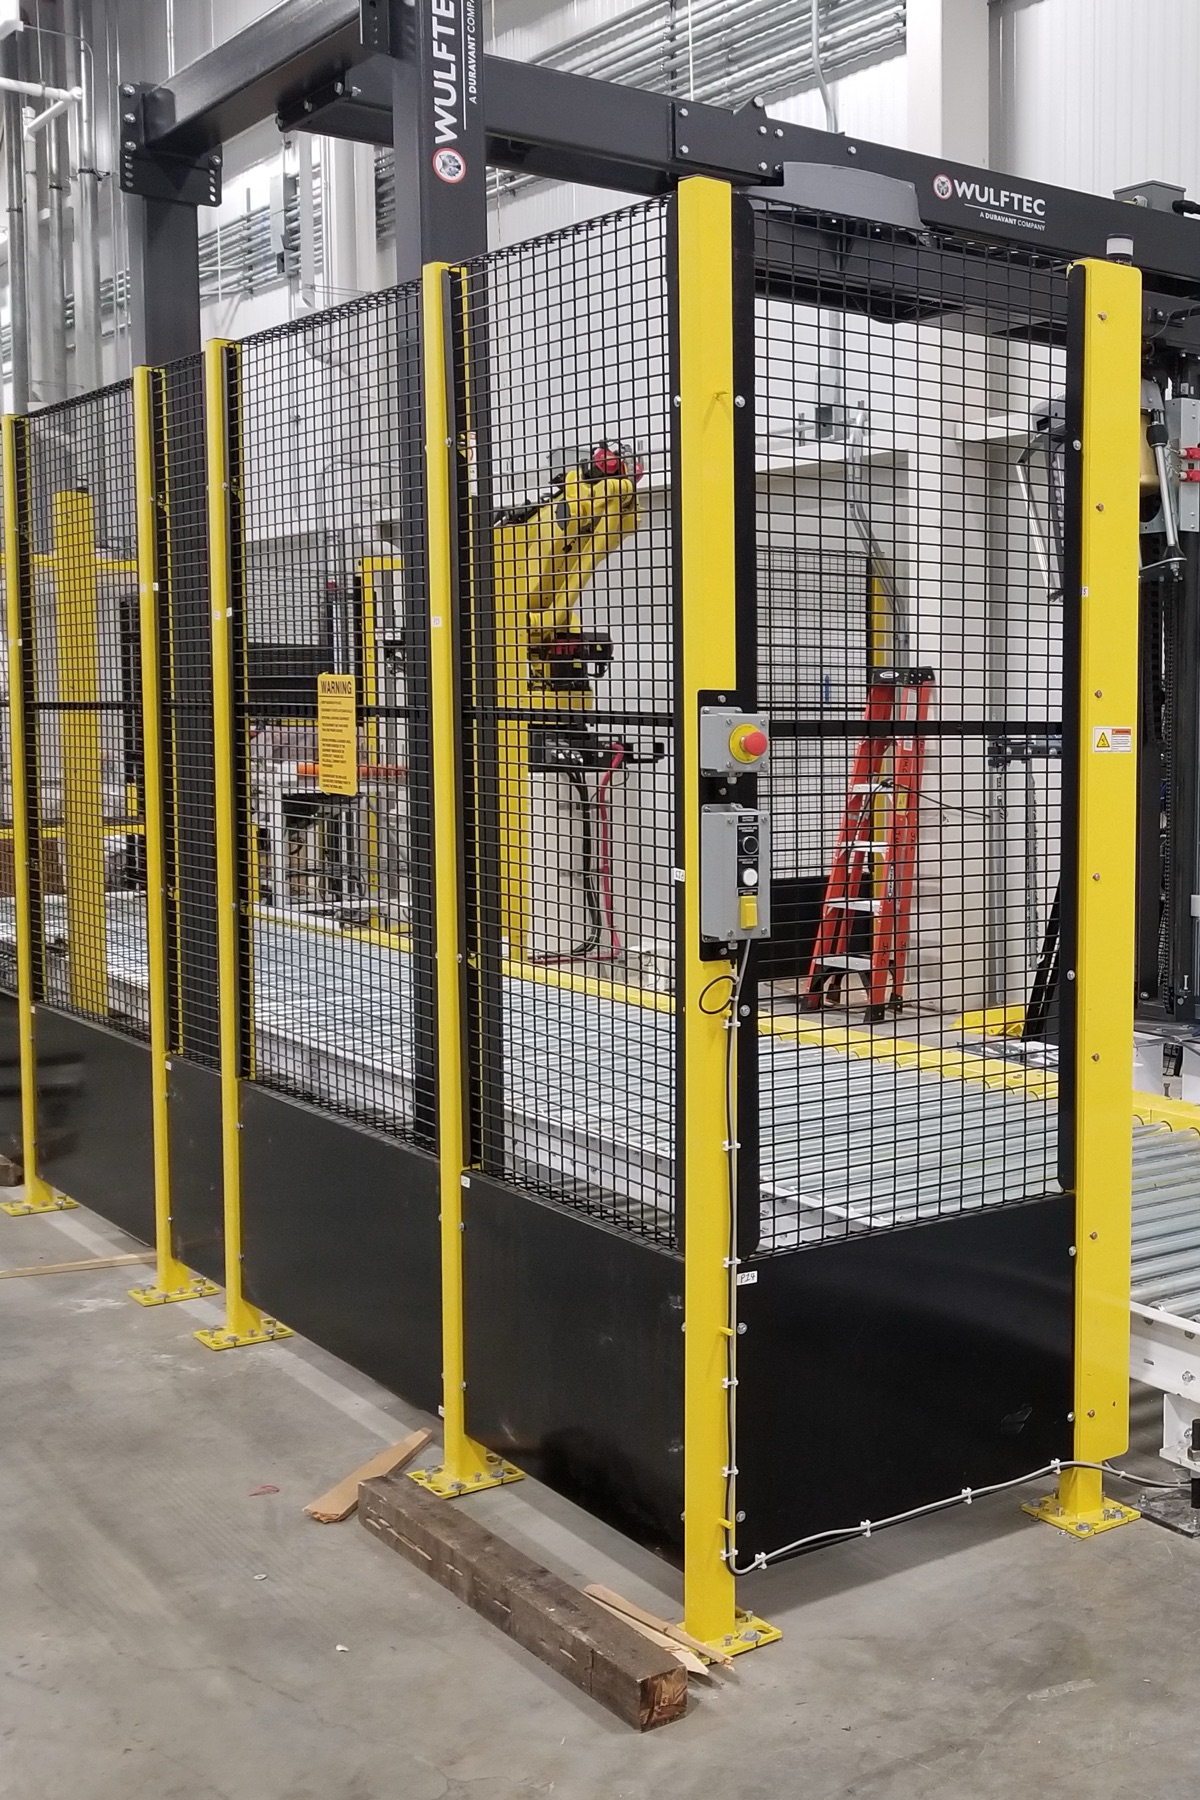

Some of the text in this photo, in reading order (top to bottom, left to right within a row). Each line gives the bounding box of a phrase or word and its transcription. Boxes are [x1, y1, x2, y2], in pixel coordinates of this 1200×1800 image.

[466, 0, 477, 104] A DURAVANT COMP
[431, 0, 458, 144] WULFTE
[953, 179, 1046, 216] WULFTEC
[985, 213, 1017, 226] DURAVANT
[1017, 219, 1046, 232] COMPANY
[320, 680, 352, 695] WARNING
